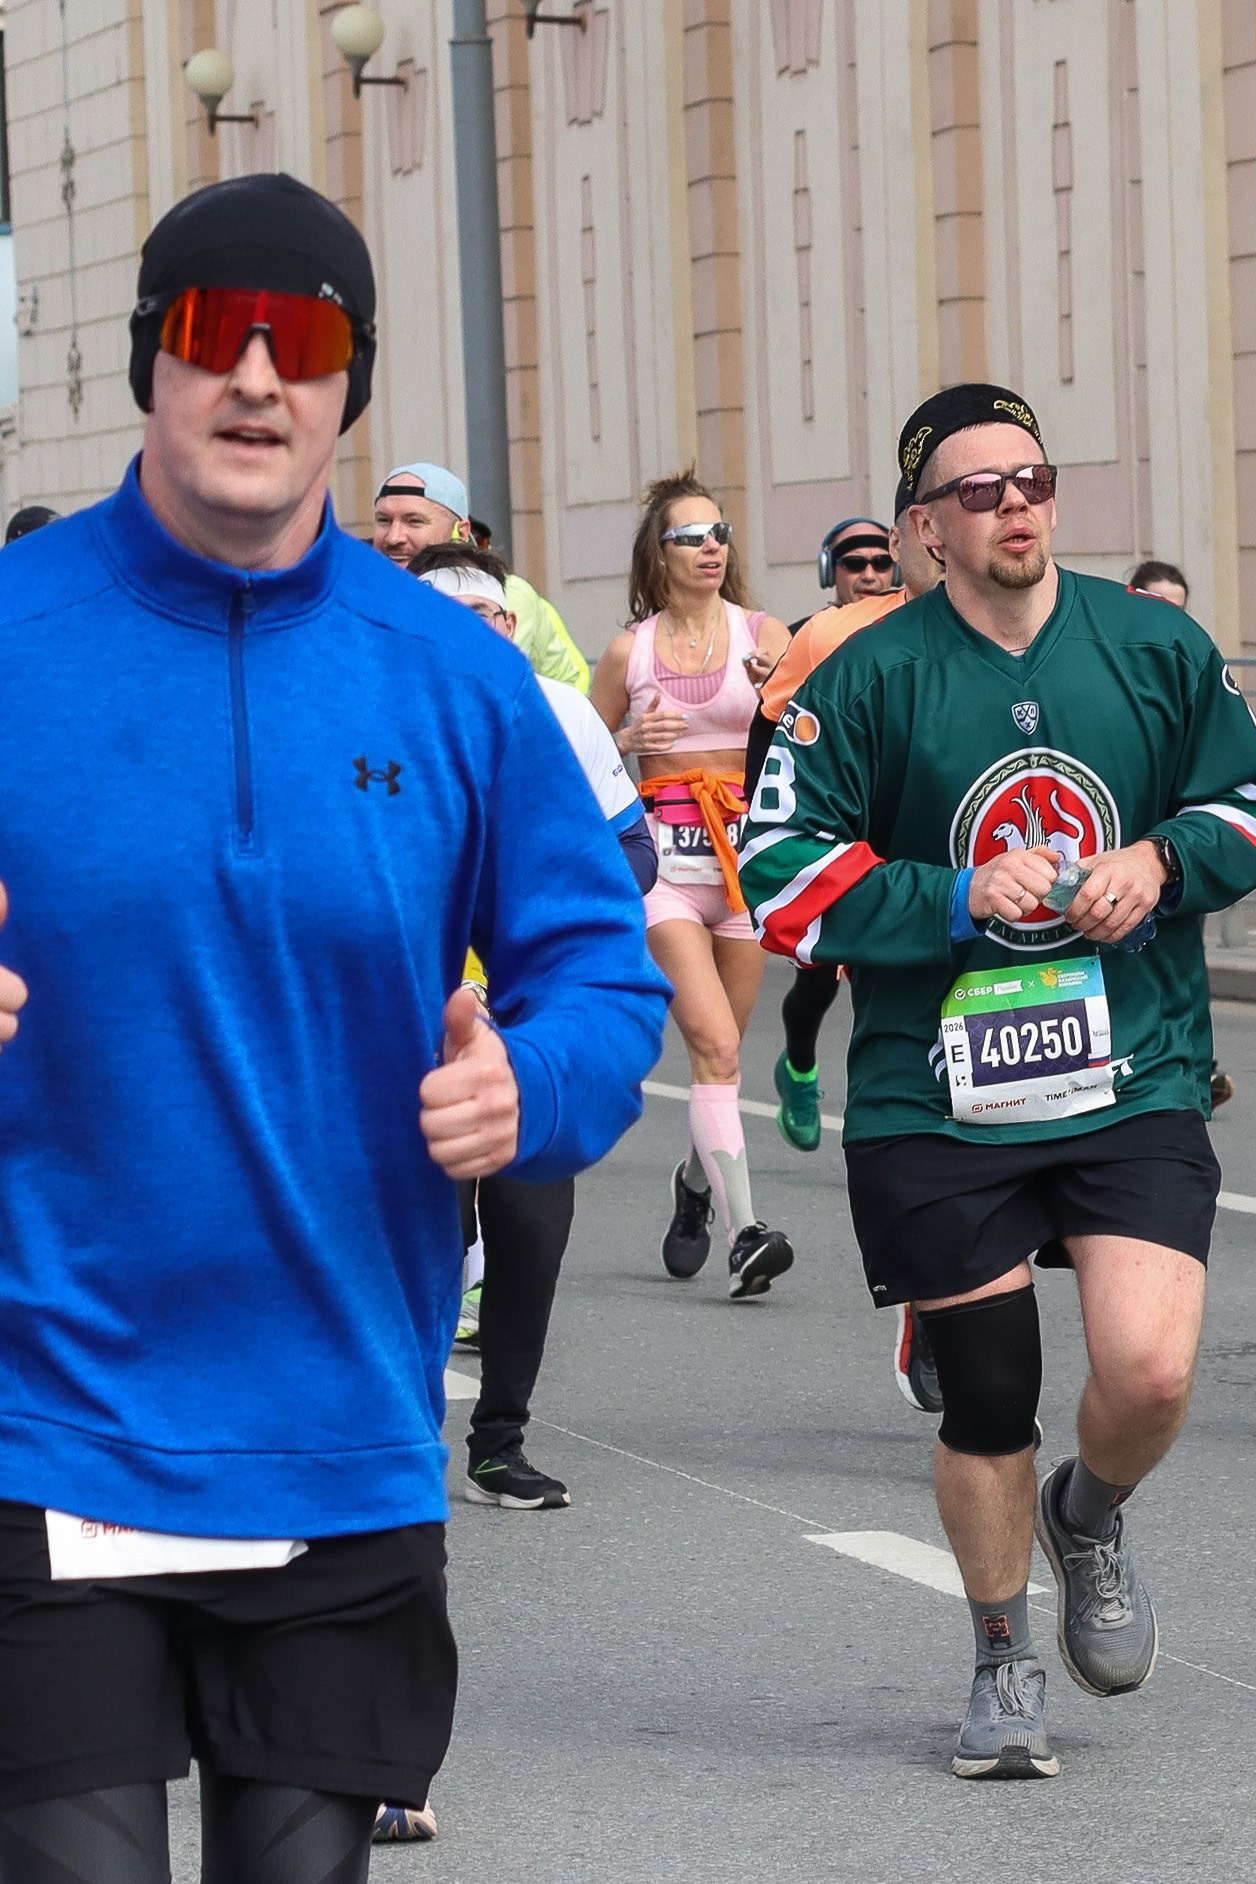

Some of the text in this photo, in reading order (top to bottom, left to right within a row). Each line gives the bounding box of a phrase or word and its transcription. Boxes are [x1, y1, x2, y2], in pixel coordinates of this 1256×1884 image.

[967, 986, 993, 998] СБЕР
[943, 1022, 964, 1033] 2026
[980, 1016, 1083, 1068] 40250
[951, 1044, 965, 1063] E
[985, 1098, 1027, 1111] МАГНИТ
